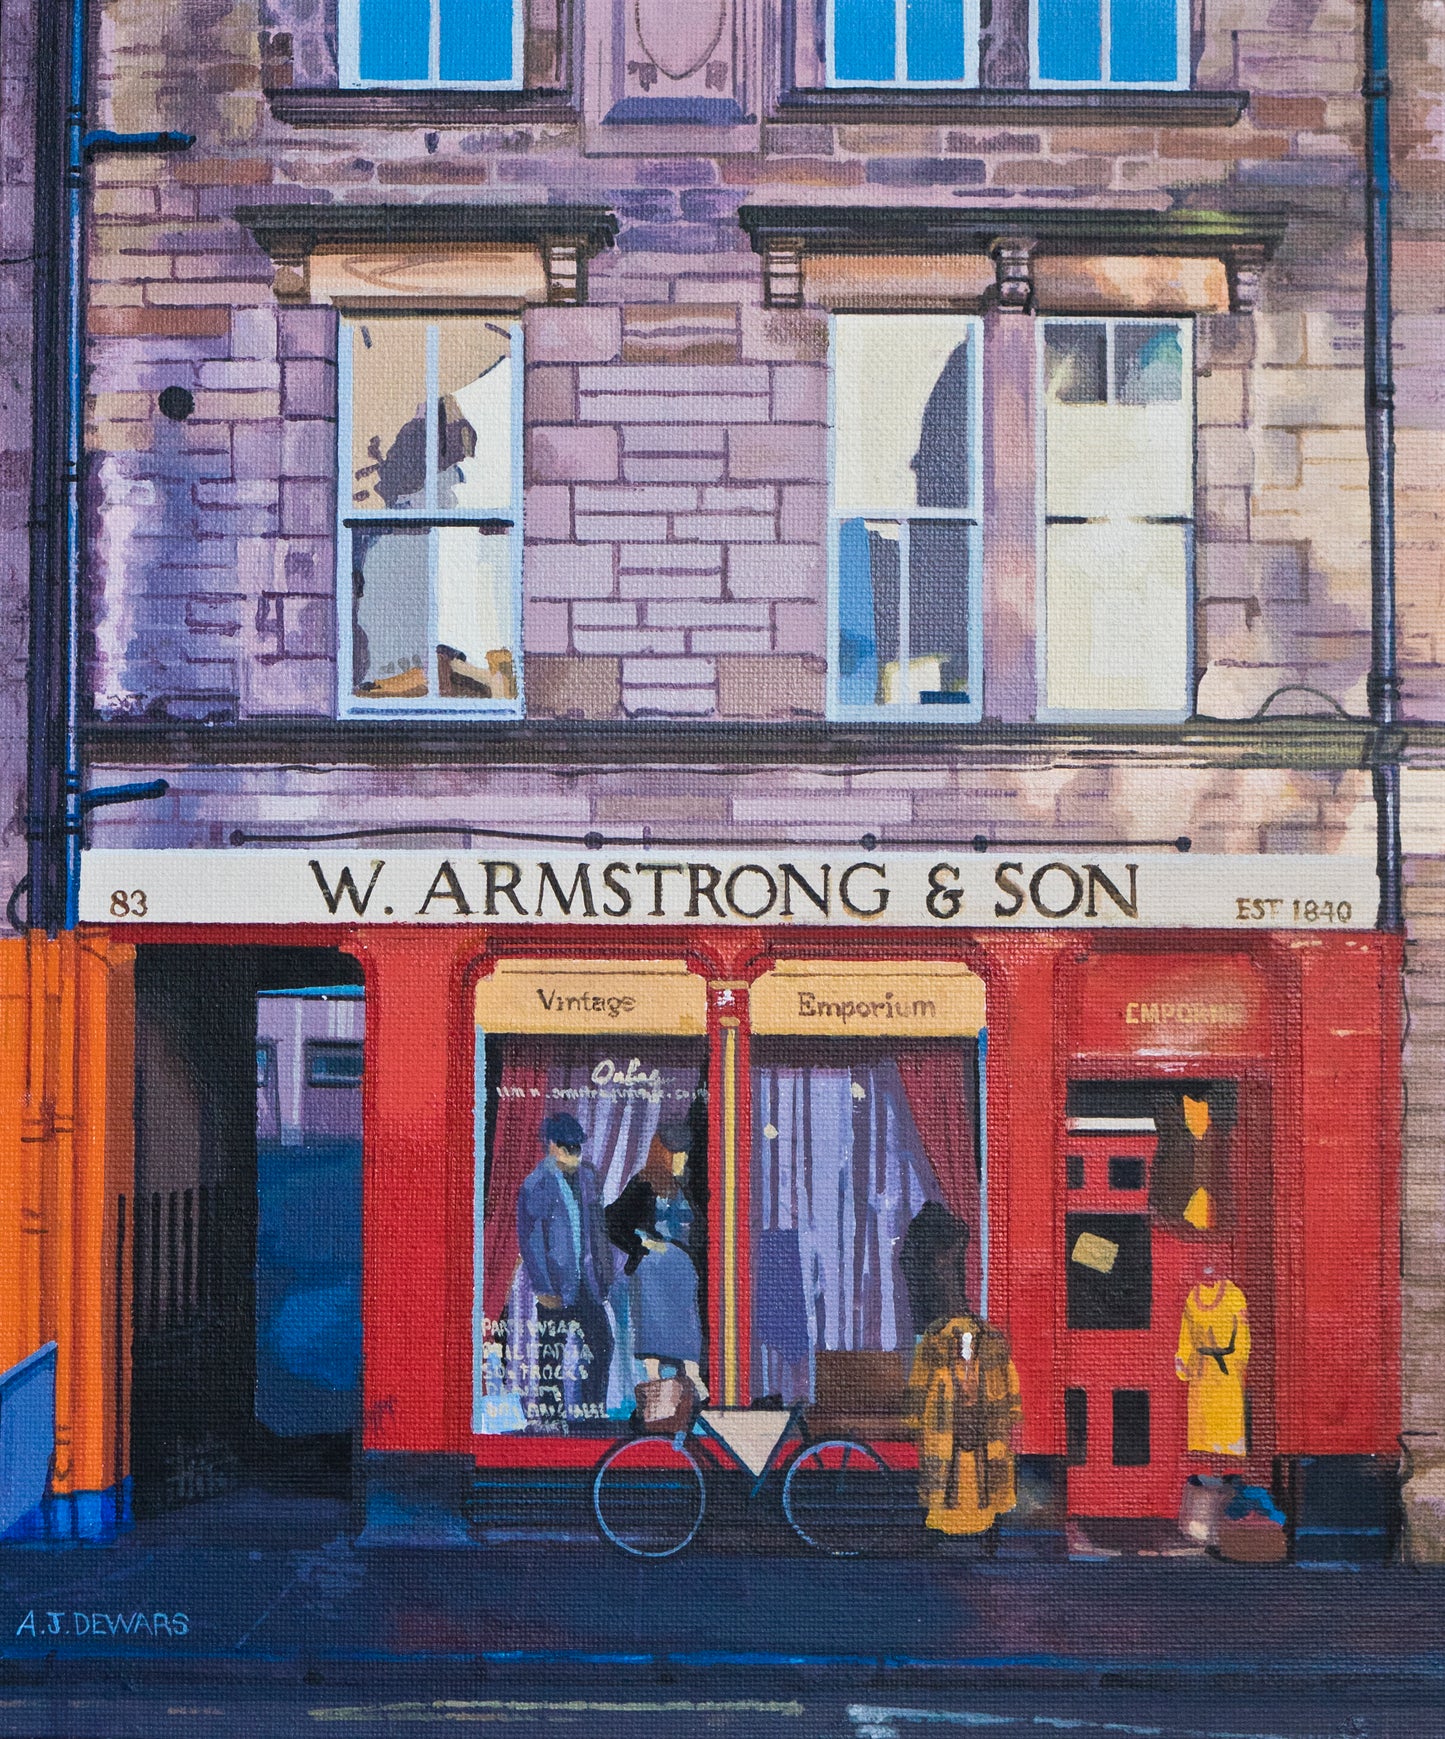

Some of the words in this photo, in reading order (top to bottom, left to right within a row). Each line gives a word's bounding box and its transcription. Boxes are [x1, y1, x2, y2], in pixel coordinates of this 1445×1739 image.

[109, 888, 149, 917] 83
[307, 859, 394, 917] W.
[414, 859, 891, 920] ARMSTRONG
[925, 861, 965, 919] &
[994, 861, 1140, 919] SON
[1235, 897, 1284, 920] EST
[1292, 898, 1353, 923] 1840
[536, 988, 637, 1019] Vintage
[797, 990, 937, 1025] Emporium
